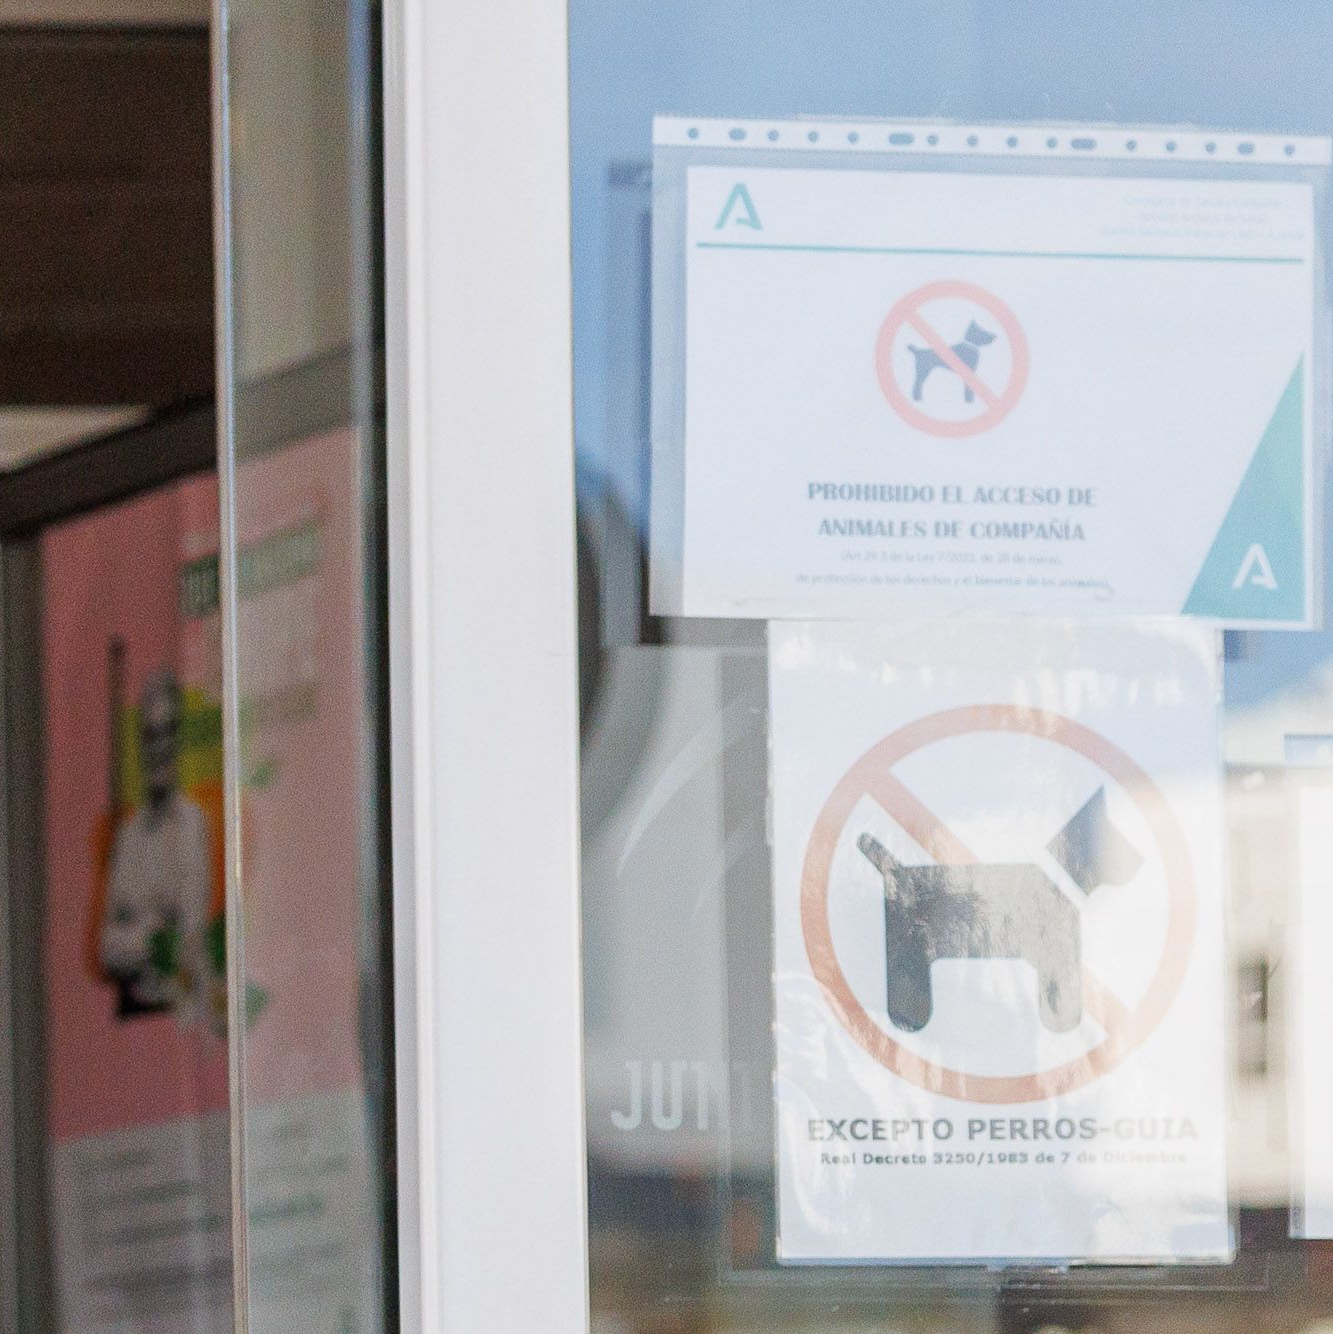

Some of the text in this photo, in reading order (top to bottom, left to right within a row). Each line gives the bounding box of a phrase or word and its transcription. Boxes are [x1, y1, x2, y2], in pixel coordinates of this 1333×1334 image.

[808, 481, 1098, 507] PROHIBIDO EL ACCESO DE
[817, 517, 1087, 542] ANIMALES DE COMPAÑÍA
[808, 1117, 1198, 1142] EXCEPTO PERROS-GUIA
[820, 1153, 856, 1165] Real
[862, 1152, 927, 1166] Decreto
[1034, 1152, 1055, 1165] de
[1060, 1152, 1071, 1164] 7
[1076, 1152, 1097, 1165] de
[1102, 1152, 1188, 1165] Diciembre
